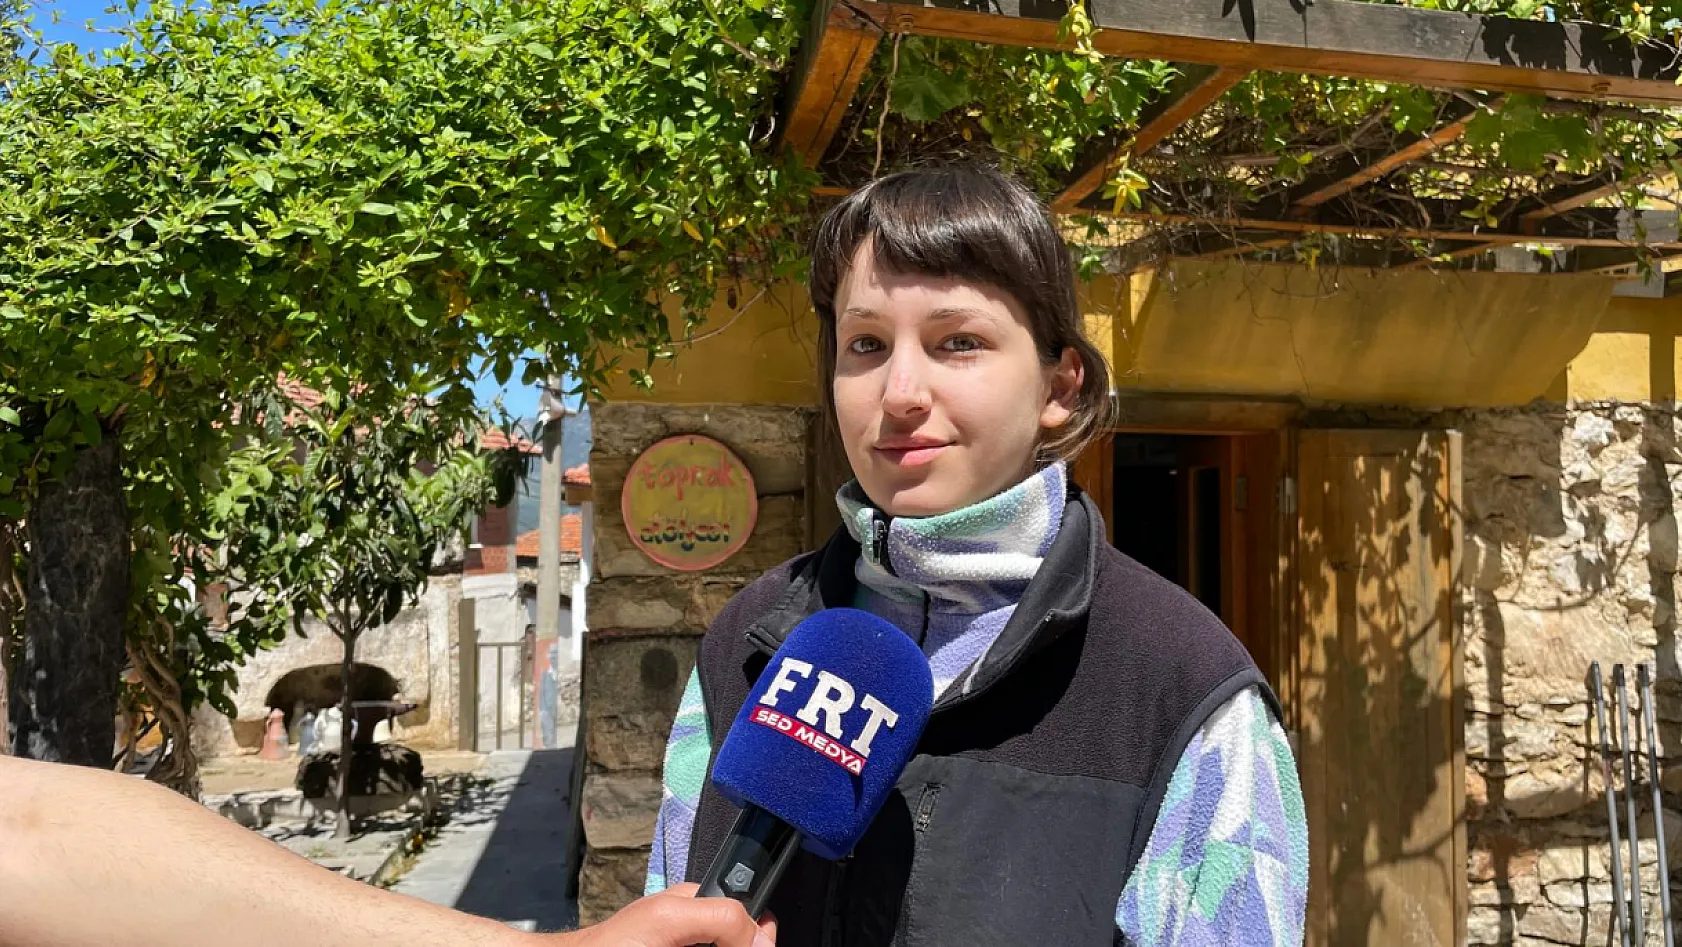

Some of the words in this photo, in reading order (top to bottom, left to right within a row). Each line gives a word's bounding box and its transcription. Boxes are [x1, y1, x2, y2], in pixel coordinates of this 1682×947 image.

[641, 456, 736, 501] toprak
[760, 657, 899, 757] FRT
[757, 710, 792, 730] SED
[794, 727, 862, 775] MEDYA
